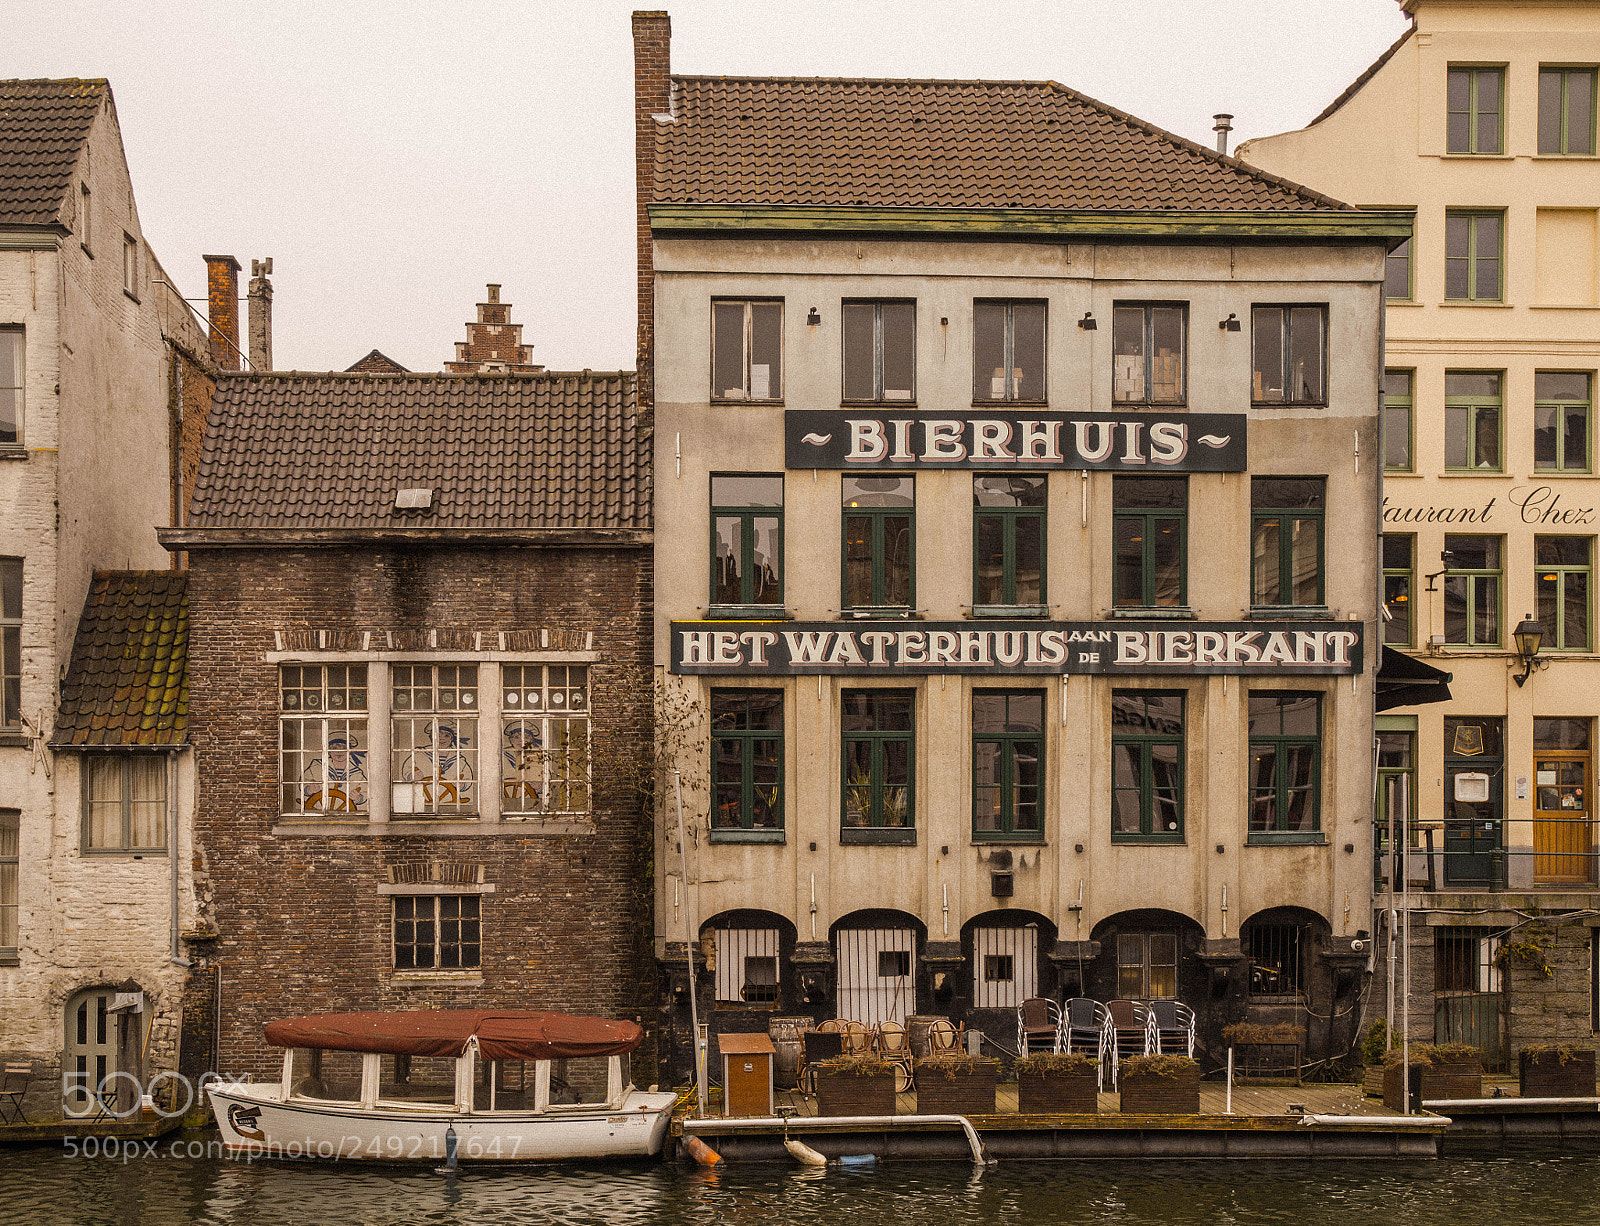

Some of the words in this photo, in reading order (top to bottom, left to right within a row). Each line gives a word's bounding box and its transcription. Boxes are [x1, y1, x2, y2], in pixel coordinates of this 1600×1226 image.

[844, 419, 1189, 465] BIERHUIS
[1508, 486, 1596, 524] Chez
[678, 631, 779, 667] HET
[780, 630, 1069, 667] WATERHUIS
[1067, 630, 1112, 642] AAN
[1112, 630, 1360, 667] BIERKANT
[1078, 652, 1100, 664] DE
